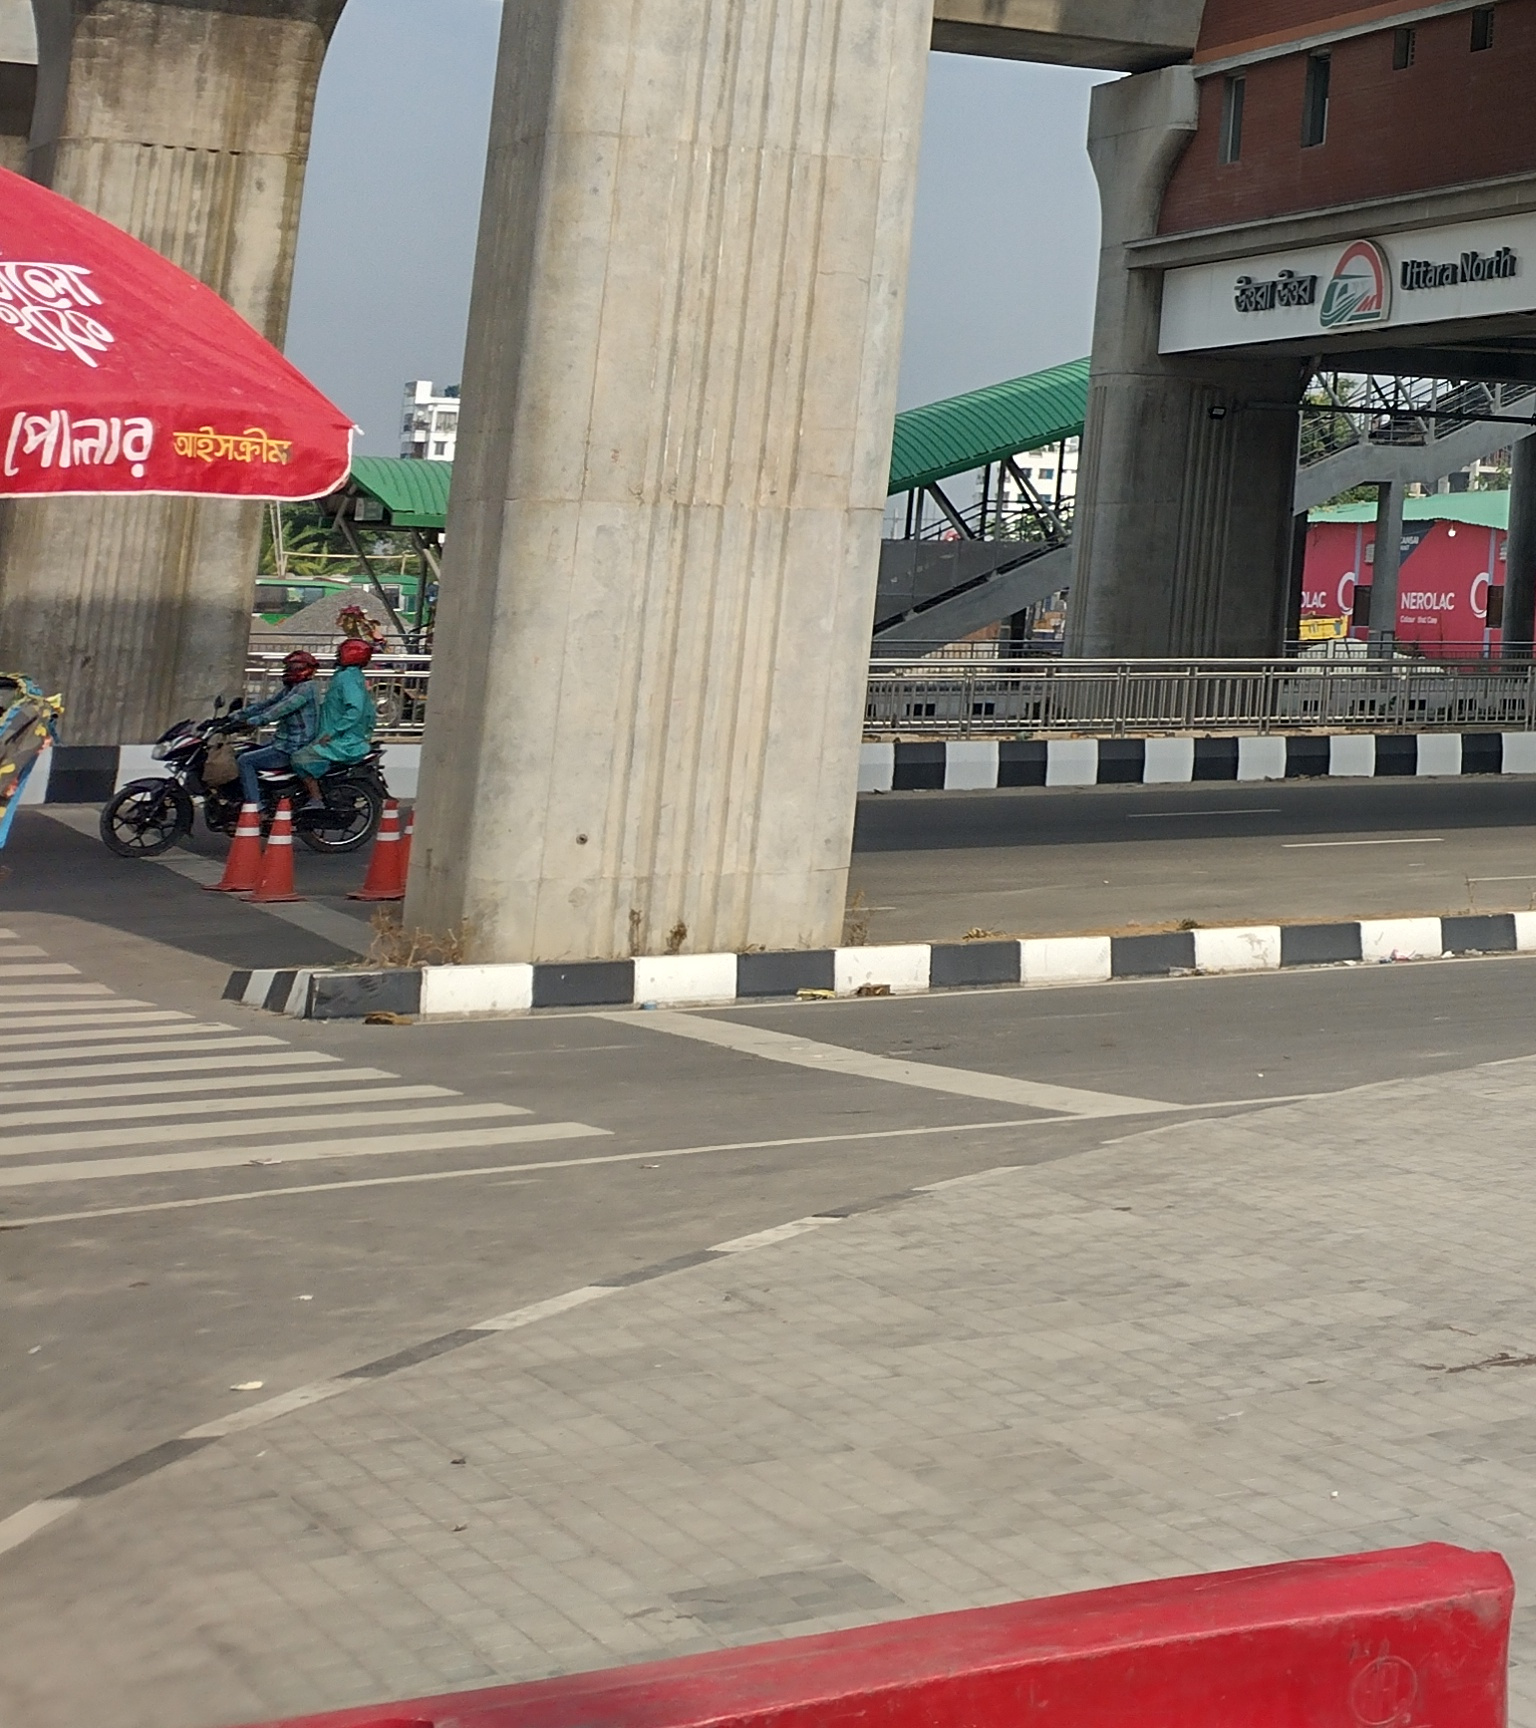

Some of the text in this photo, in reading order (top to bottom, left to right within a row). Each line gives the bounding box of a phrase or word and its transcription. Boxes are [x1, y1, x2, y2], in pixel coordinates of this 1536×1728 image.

[1400, 245, 1517, 290] Uttara North
[1234, 268, 1317, 313] উত্তরা উত্তর
[4, 409, 154, 478] পোলার
[1401, 592, 1455, 610] NEROLAC
